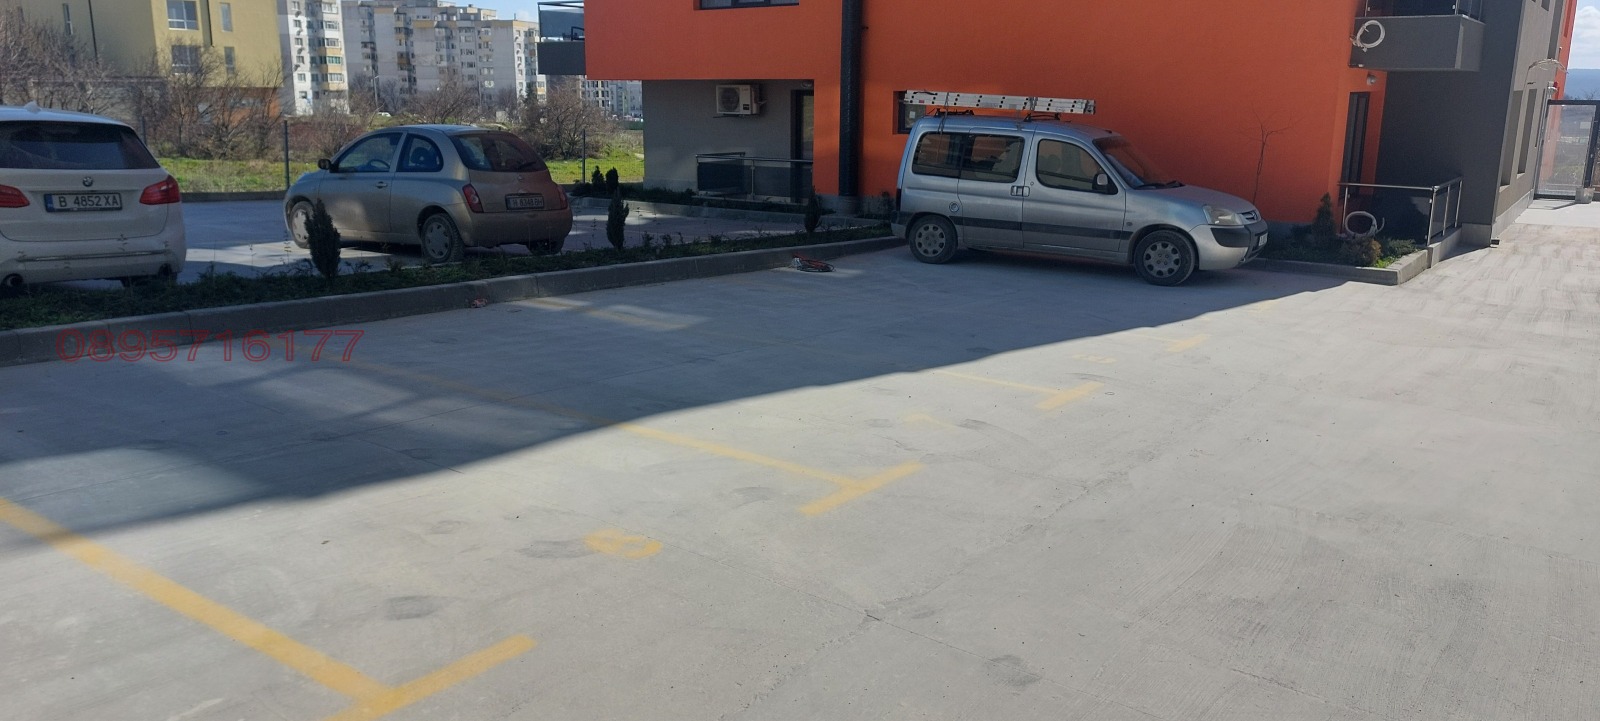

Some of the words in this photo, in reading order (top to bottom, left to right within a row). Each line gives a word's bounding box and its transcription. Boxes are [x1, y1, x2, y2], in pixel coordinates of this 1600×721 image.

[59, 196, 67, 207] B
[74, 196, 102, 207] 4852
[104, 195, 119, 206] XA
